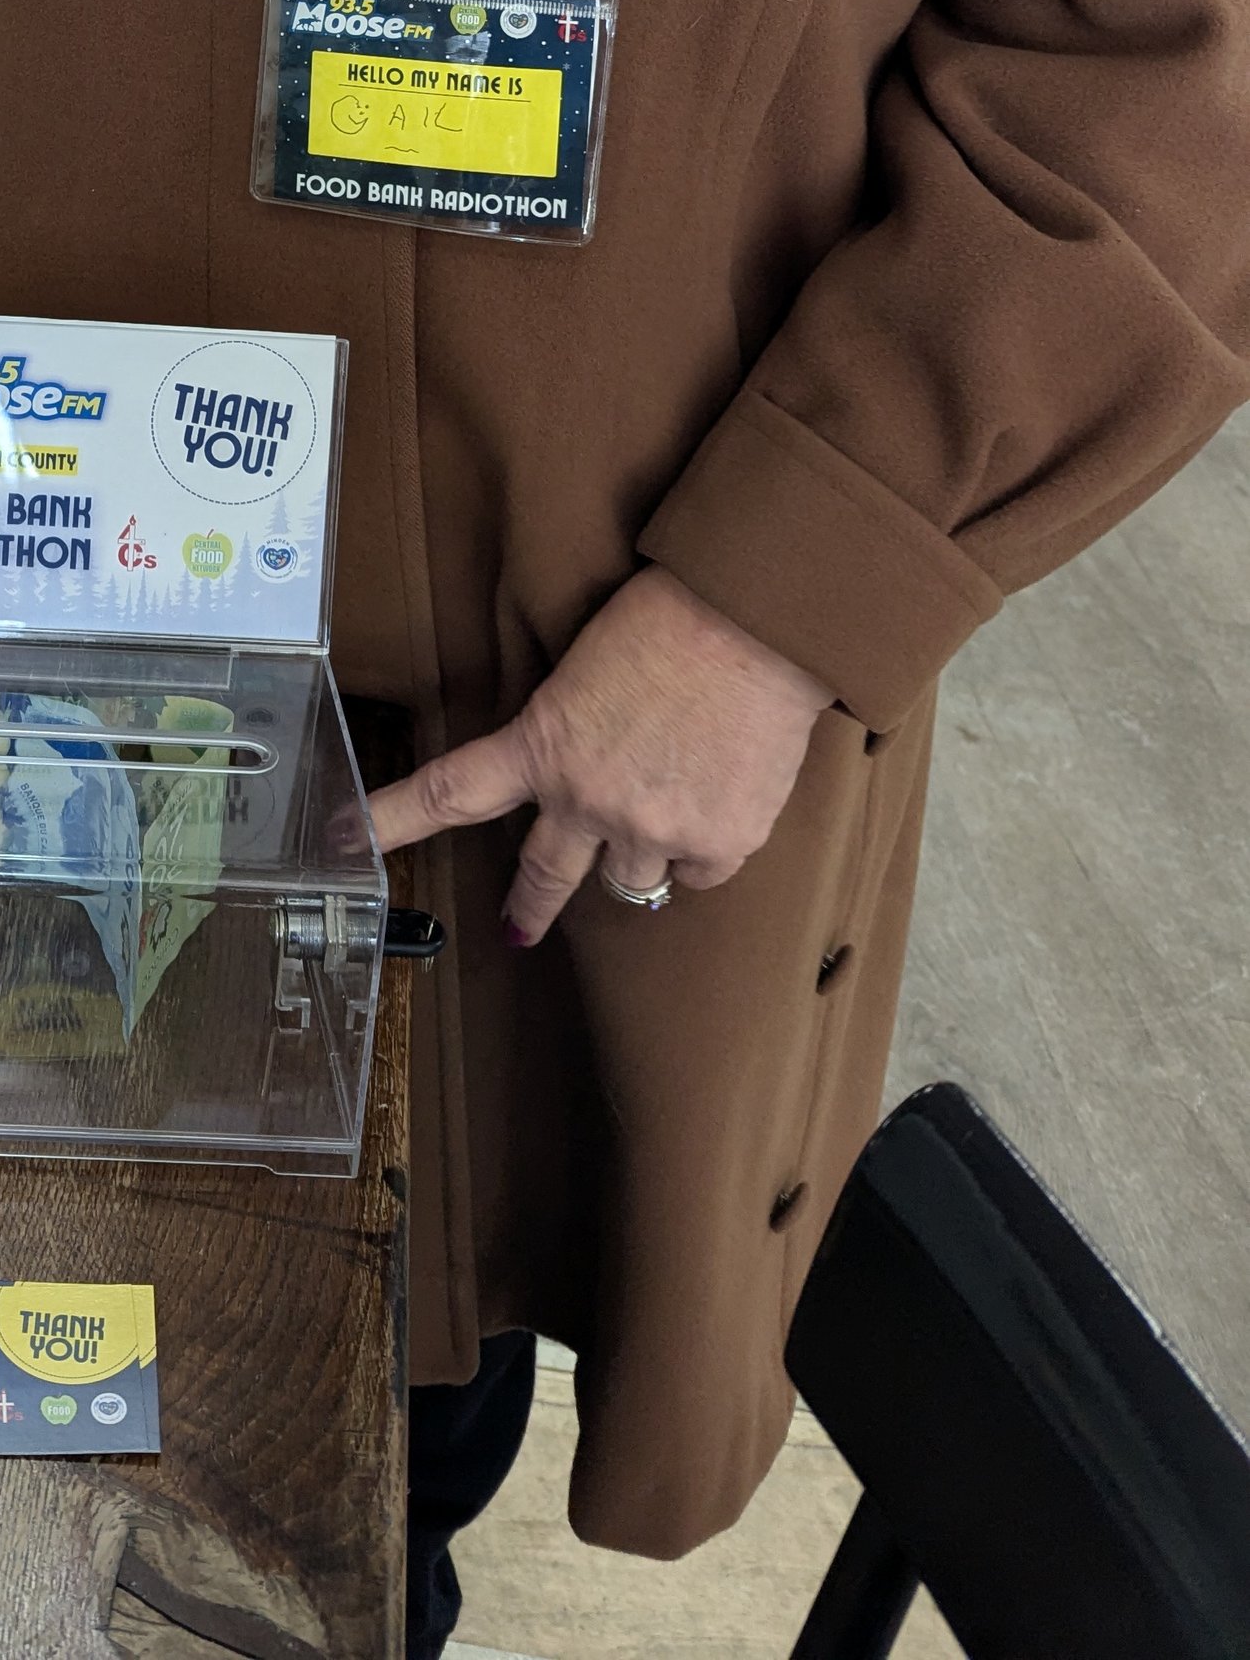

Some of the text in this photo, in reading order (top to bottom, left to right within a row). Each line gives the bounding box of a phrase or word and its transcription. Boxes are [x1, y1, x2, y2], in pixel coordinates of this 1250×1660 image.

[456, 13, 480, 25] FOOD
[347, 63, 523, 96] HELLO MY NAME IS
[295, 173, 568, 219] FOOD BANK RADIOTHON
[174, 382, 293, 441] THANK
[183, 425, 278, 477] YOU!
[7, 493, 92, 529] BANK
[190, 548, 224, 564] FOOD
[19, 782, 46, 821] BANQUE
[19, 1310, 105, 1340] THANK
[30, 1335, 98, 1364] YOU!
[48, 1405, 71, 1416] FOOD
